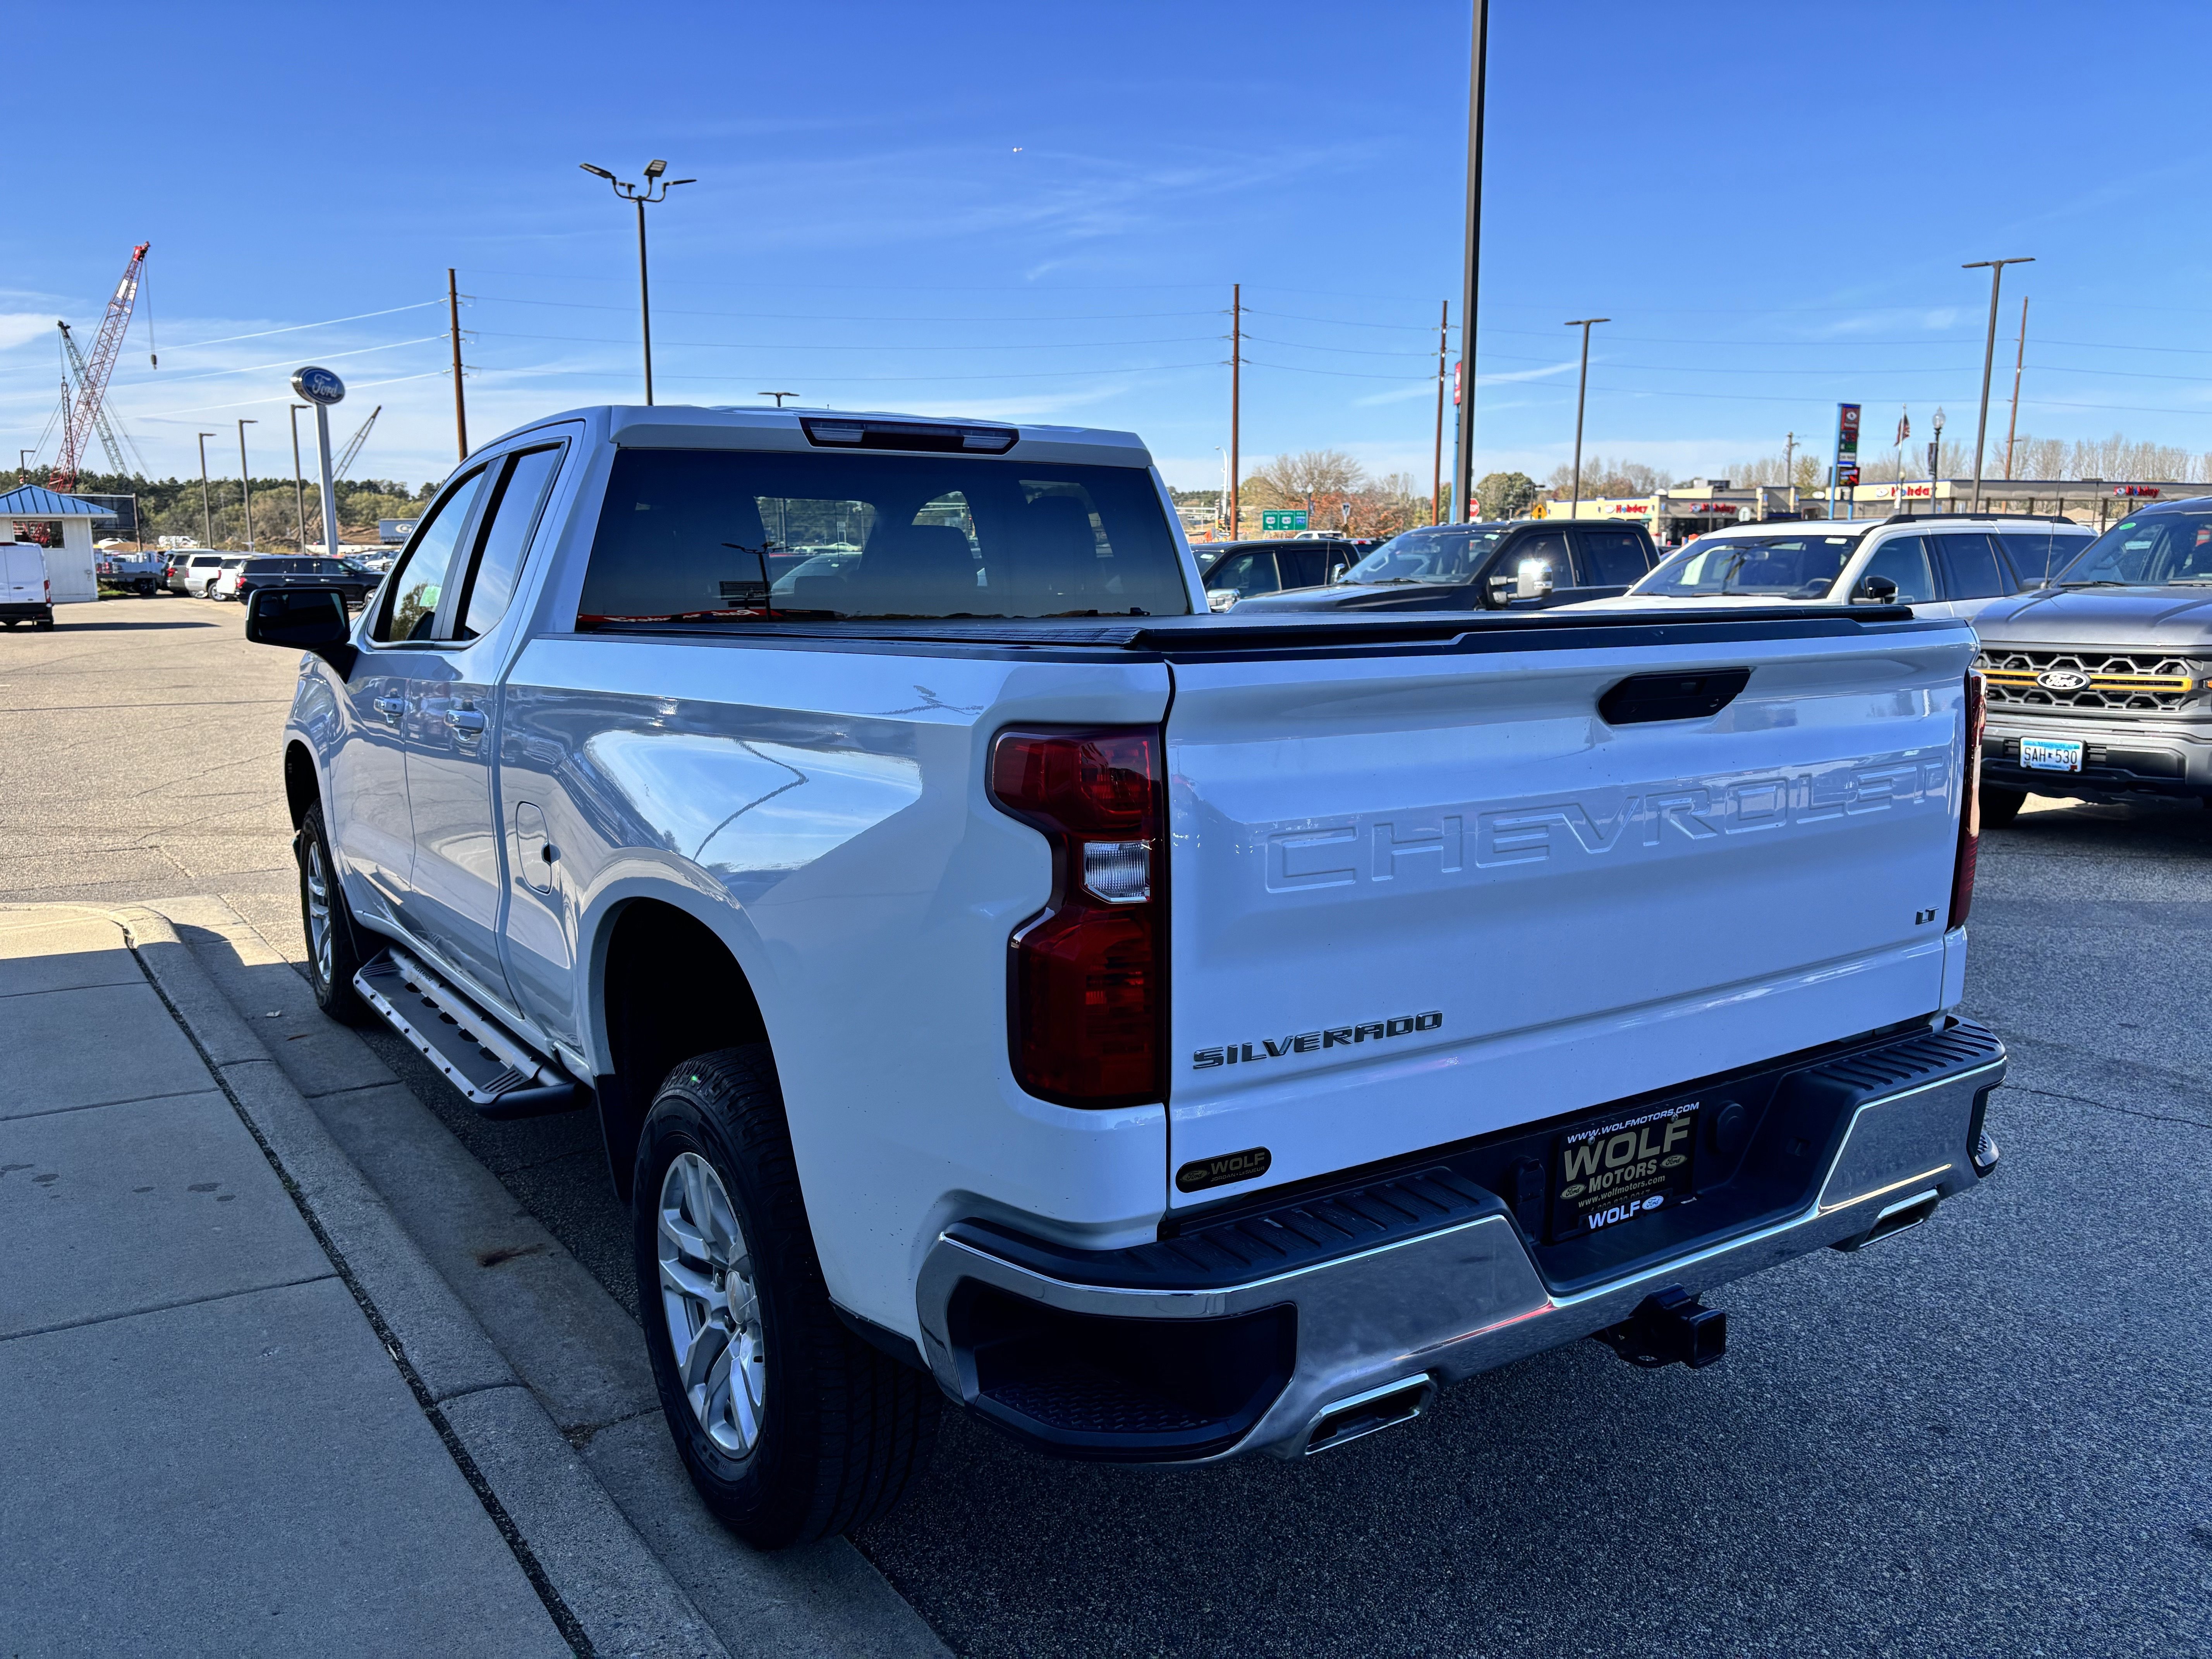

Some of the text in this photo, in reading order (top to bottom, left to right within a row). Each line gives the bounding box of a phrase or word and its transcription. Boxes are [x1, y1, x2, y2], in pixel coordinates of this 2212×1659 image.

[312, 373, 338, 397] Ford
[1891, 486, 1934, 498] Holida
[1616, 504, 1648, 514] Holiday
[2046, 673, 2077, 687] Ford
[2024, 747, 2077, 764] SAH 530
[1265, 756, 1945, 893] CHEVROLET
[1915, 907, 1939, 925] LT
[1193, 1010, 1443, 1070] SILVERADO
[1567, 1102, 1700, 1144] WWW.WOLFMOTORS.COM
[1564, 1117, 1690, 1182] WOLF
[1211, 1152, 1265, 1175] WOLF
[1186, 1171, 1203, 1180] Ford
[1211, 1173, 1236, 1182] JORDAN
[1589, 1159, 1657, 1194] MOTORS
[1578, 1175, 1665, 1208] www.wolfmotors.com
[1589, 1200, 1641, 1229] WOLF
